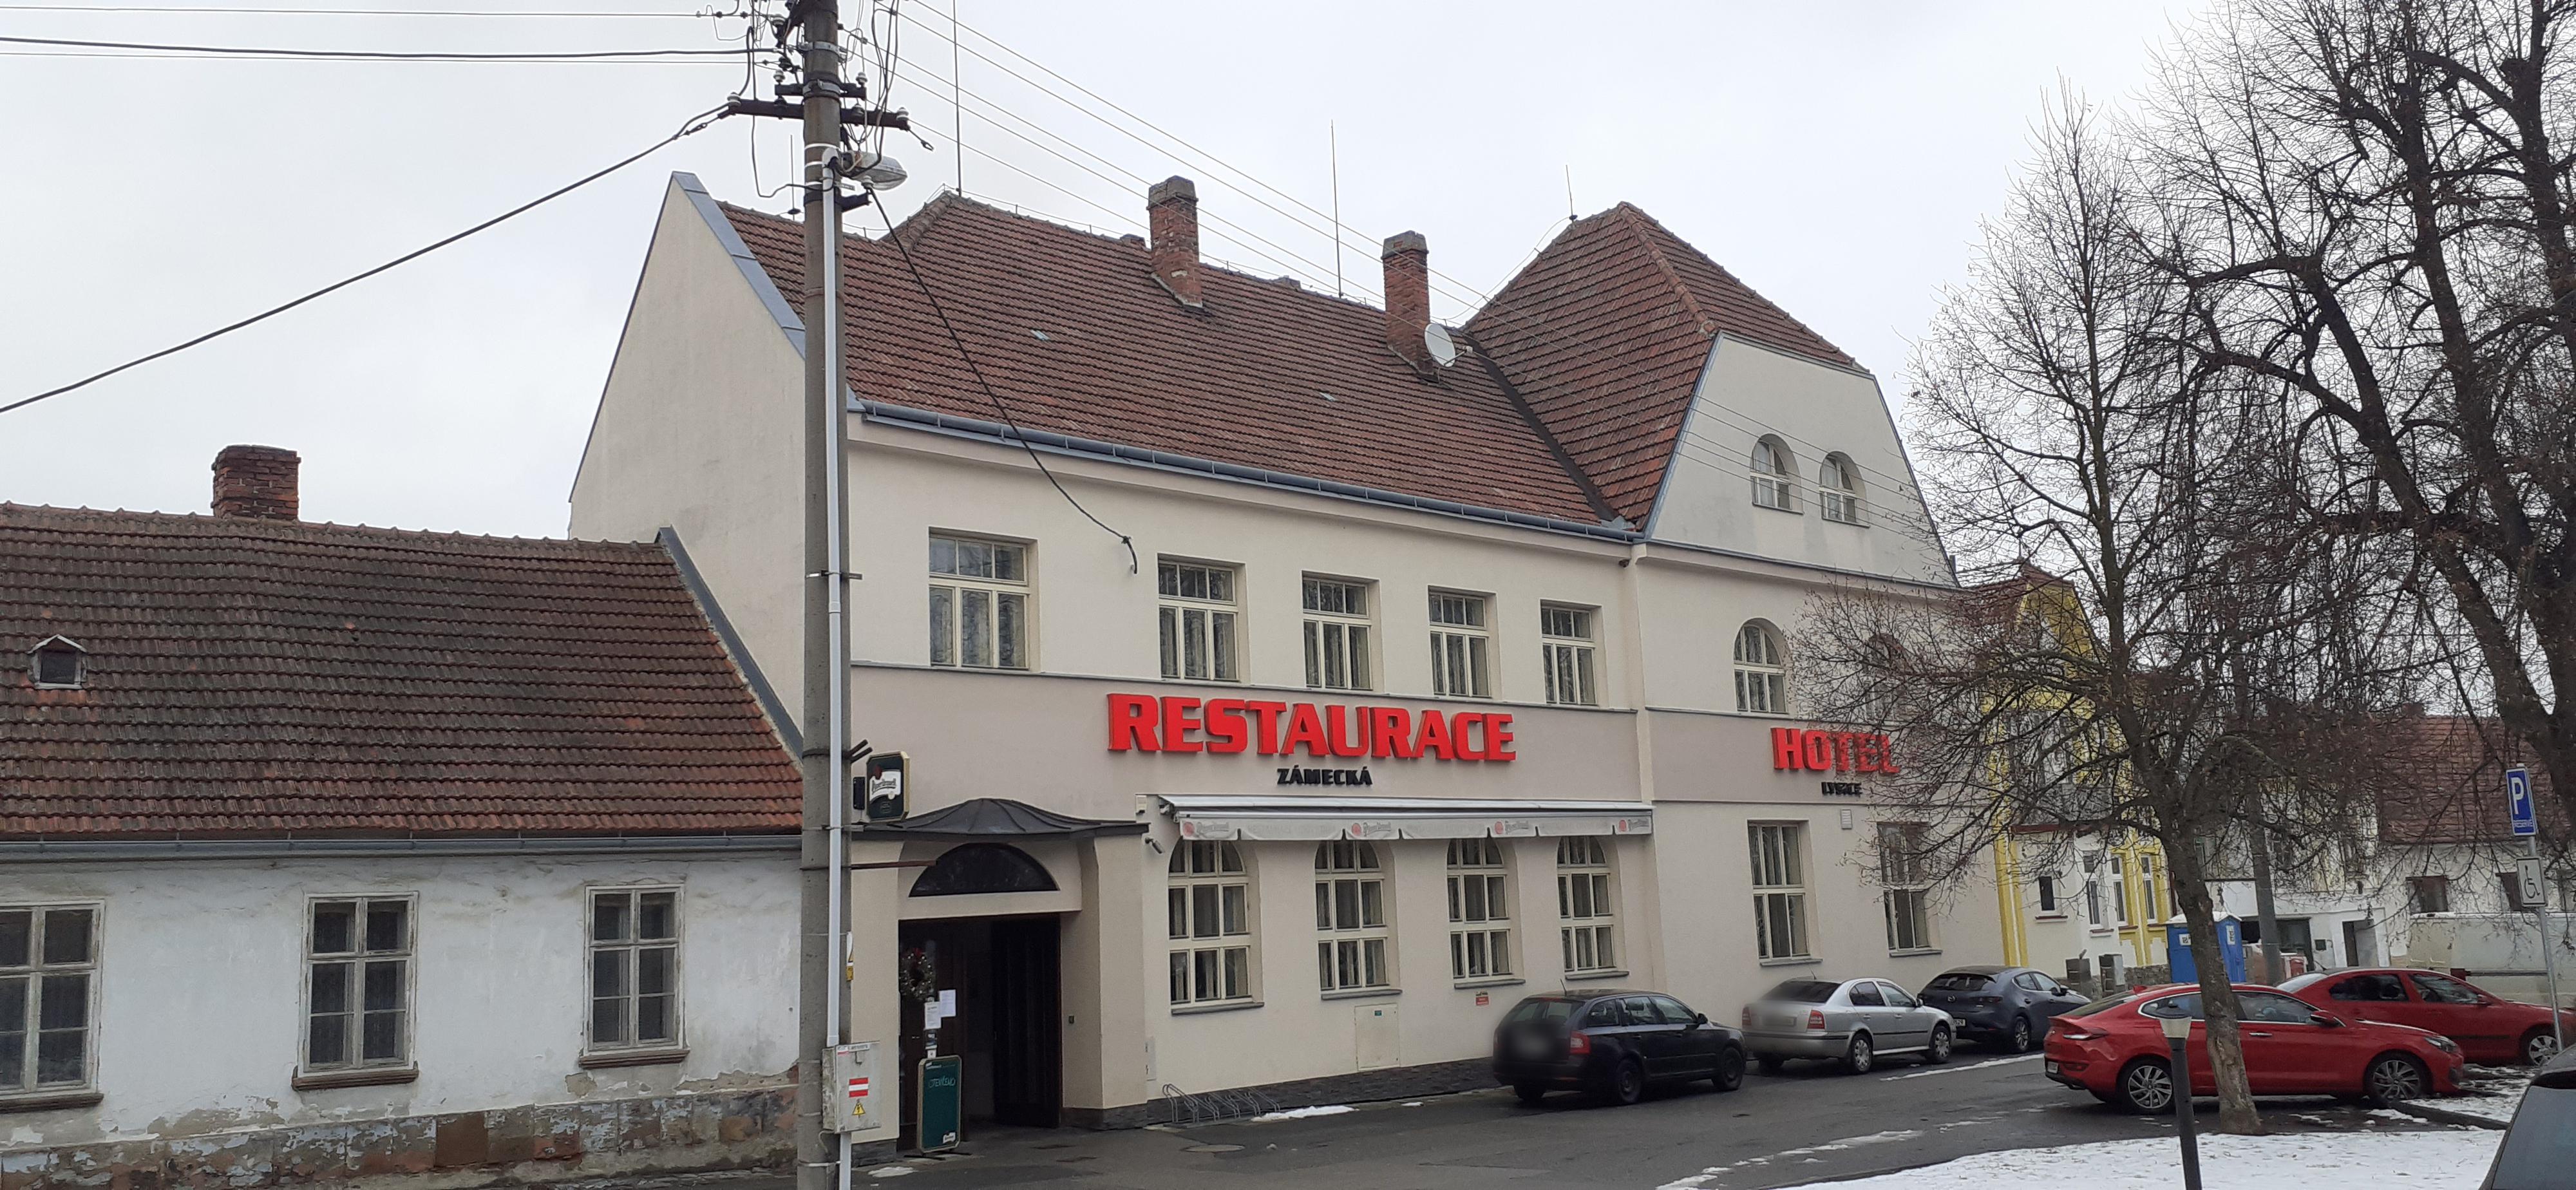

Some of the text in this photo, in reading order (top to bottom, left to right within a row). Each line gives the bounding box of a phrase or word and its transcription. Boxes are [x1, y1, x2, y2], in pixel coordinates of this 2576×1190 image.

[1107, 693, 1516, 762] RESTAURACE
[1770, 727, 1900, 775] HOTEL
[1277, 764, 1372, 785] ZÁMECKÁ
[2511, 777, 2524, 815] P
